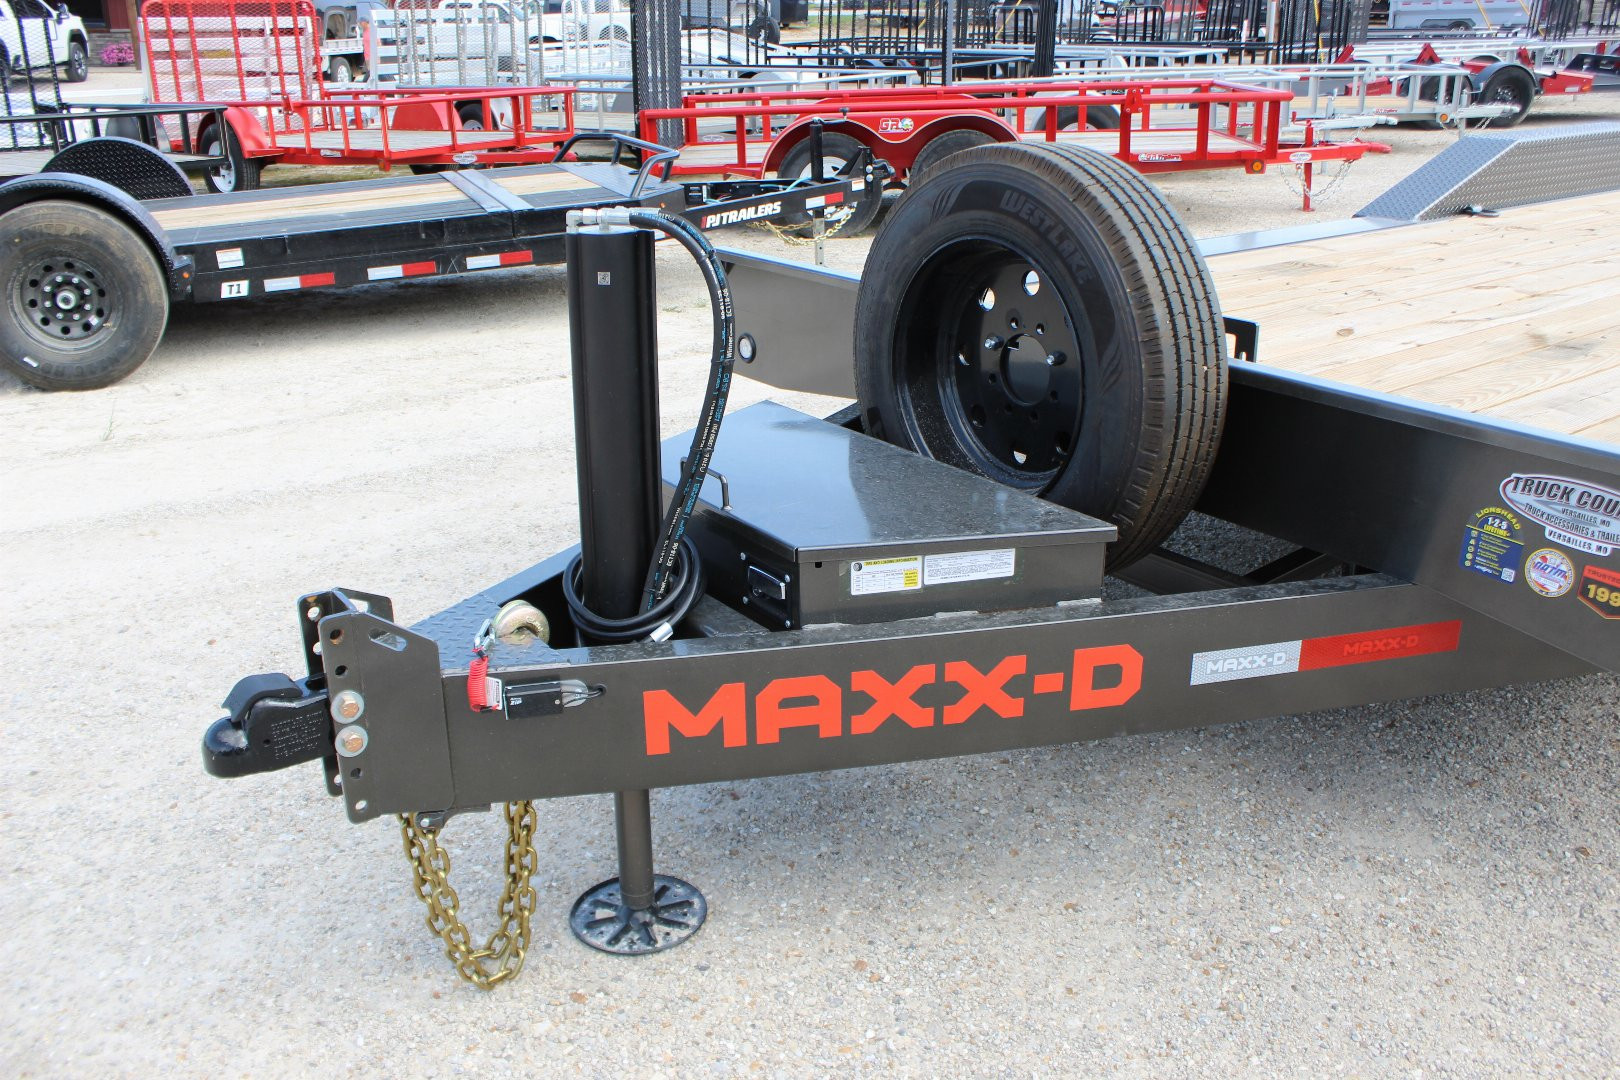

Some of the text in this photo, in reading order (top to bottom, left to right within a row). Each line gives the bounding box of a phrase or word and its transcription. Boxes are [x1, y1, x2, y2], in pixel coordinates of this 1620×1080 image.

[721, 201, 782, 224] TRAILERS
[227, 283, 242, 296] T1
[1511, 476, 1575, 504] TRUCK
[1475, 507, 1521, 530] LIONSHEAD
[1524, 502, 1546, 520] TRUCK
[1544, 513, 1590, 537] ACCESSORIES
[1597, 530, 1620, 543] TRAILE
[1599, 518, 1611, 528] MO
[1595, 544, 1608, 555] MO
[1343, 634, 1420, 656] MAXX-D
[1204, 651, 1287, 675] MAXX-D
[642, 643, 1144, 756] MAXX-D
